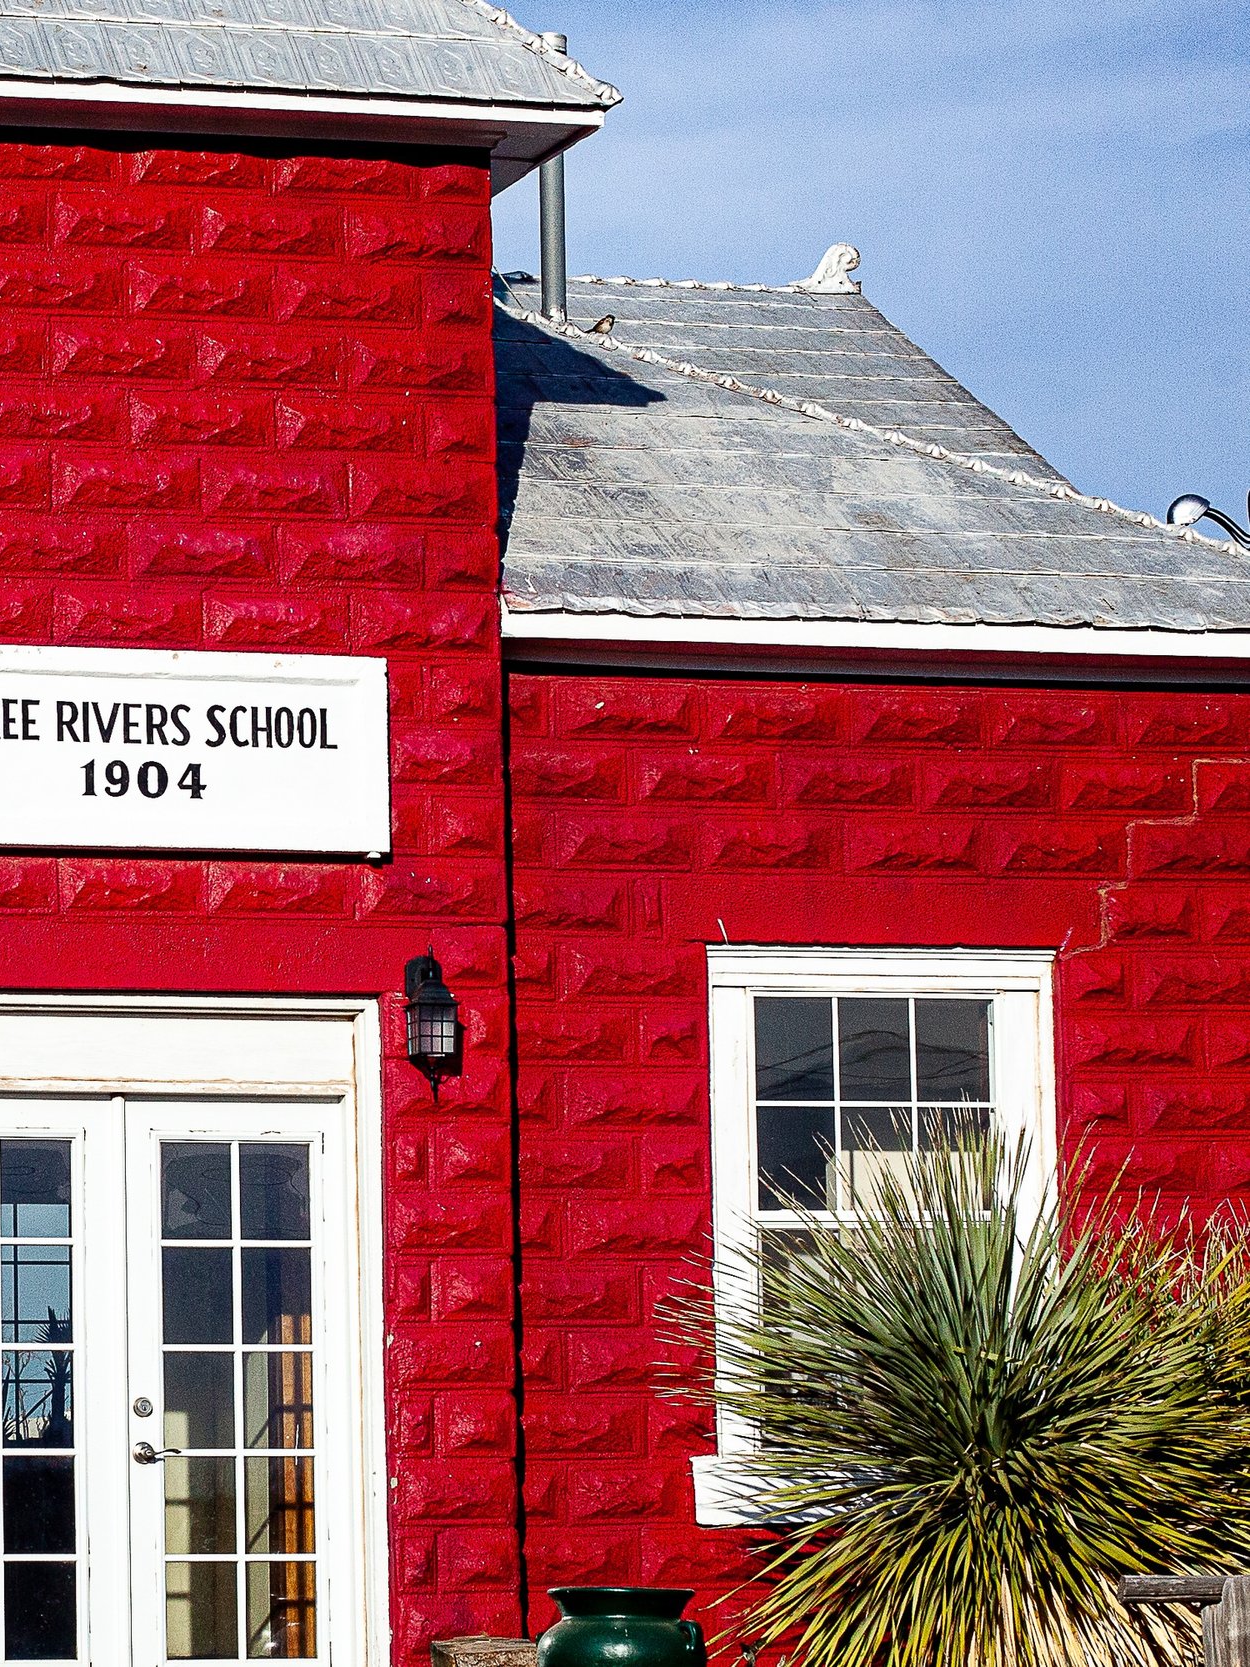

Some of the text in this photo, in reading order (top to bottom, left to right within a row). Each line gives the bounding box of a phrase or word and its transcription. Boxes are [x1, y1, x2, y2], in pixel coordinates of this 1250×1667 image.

[57, 701, 191, 746] RIVERS
[205, 705, 338, 749] SCHOOL
[81, 760, 208, 800] 1904
